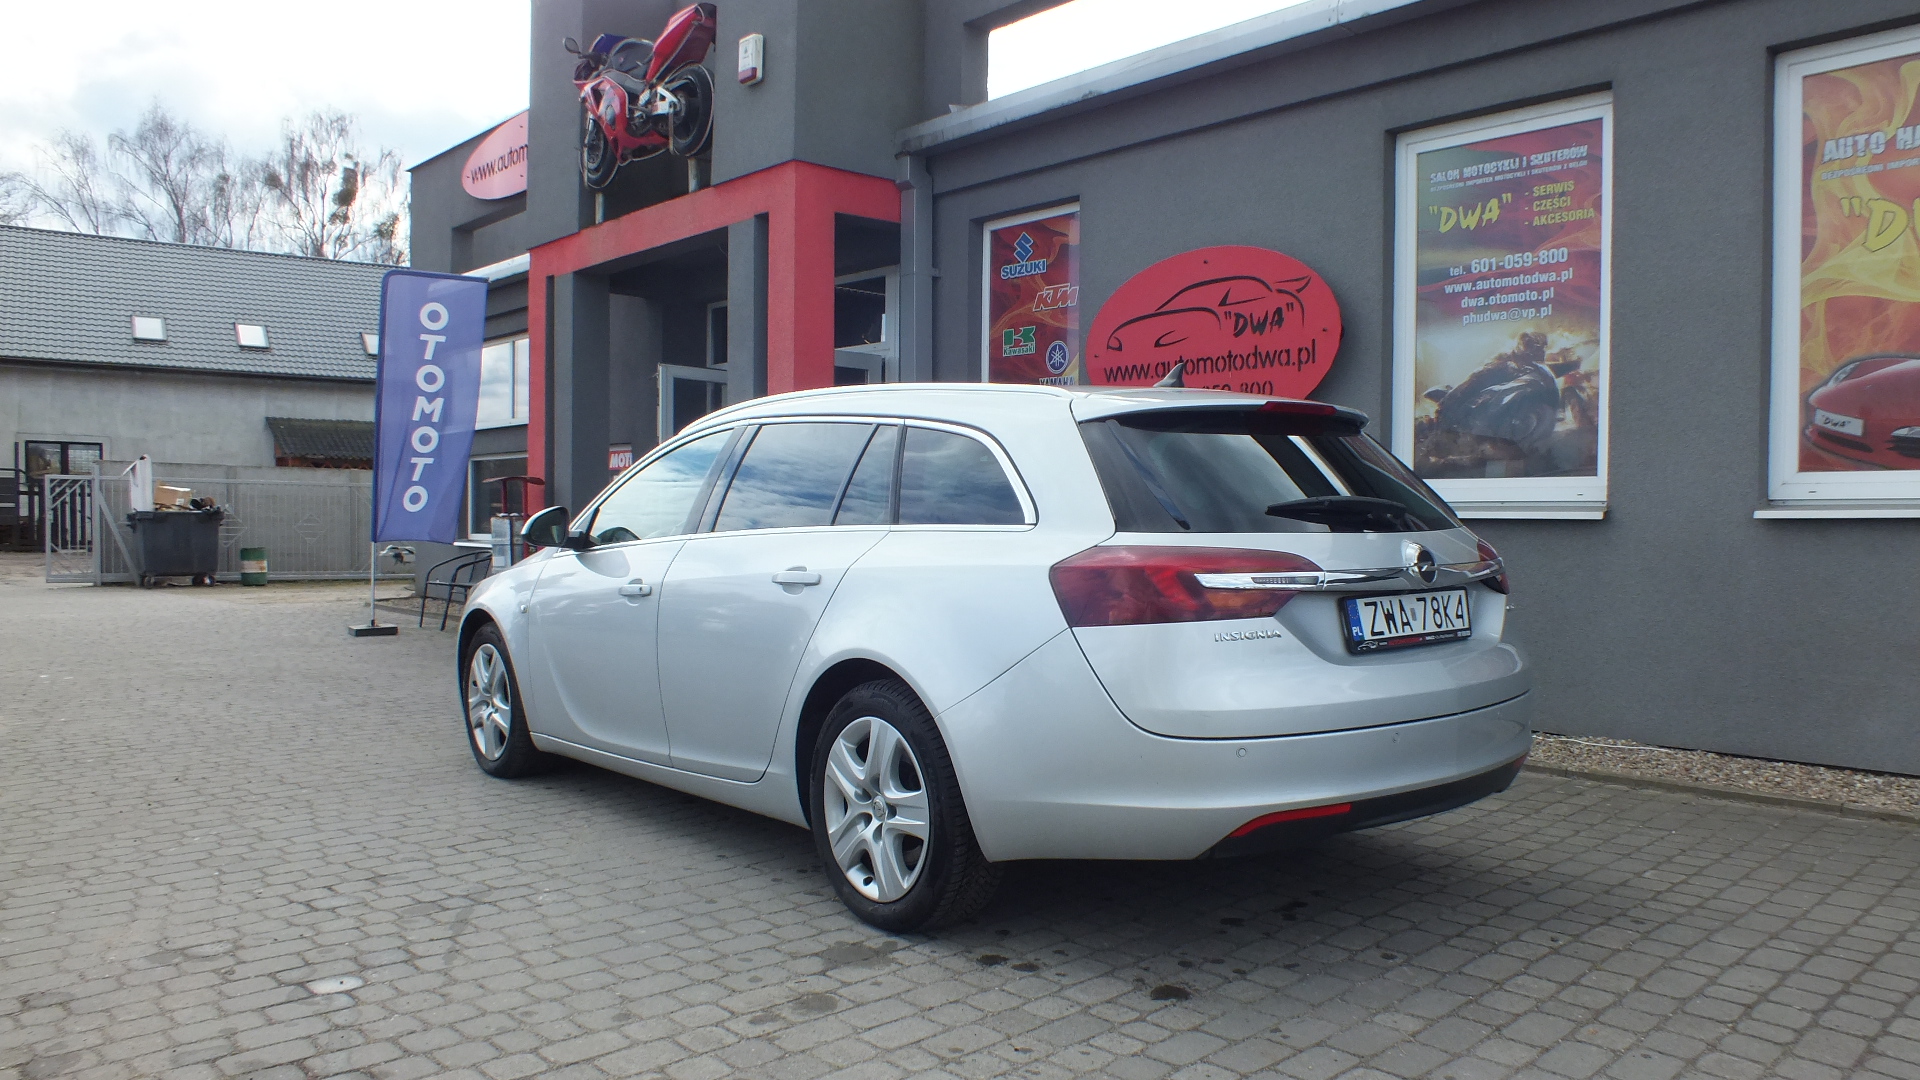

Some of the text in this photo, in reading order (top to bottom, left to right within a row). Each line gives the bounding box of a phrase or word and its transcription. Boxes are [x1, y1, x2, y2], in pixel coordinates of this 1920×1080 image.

[1821, 131, 1886, 164] AUTO
[1430, 143, 1588, 183] SALON MOTOCYKLI I SKUTERÓW
[1533, 180, 1575, 197] SERWIS
[1428, 193, 1512, 233] "DWA"
[1533, 196, 1571, 213] CZĘŚCI
[1533, 208, 1595, 226] AKCESORIA
[1001, 259, 1047, 280] SUZUKI
[1450, 247, 1568, 276] tel. 601-059-800
[1444, 268, 1573, 294] www.automotodwa.pl
[1033, 283, 1079, 312] KTM
[1461, 287, 1554, 308] dwa.otomoto.pl
[1224, 302, 1295, 338] "DWA"
[1462, 304, 1552, 326] phudwa@vp.pl
[1003, 343, 1035, 356] Kawasaki
[1039, 376, 1075, 386] YAMAHA
[403, 302, 449, 512] OTOMOTO
[1363, 593, 1465, 637] ZWA 78K4
[1213, 629, 1282, 643] INSIGNIA
[1352, 626, 1363, 637] PL
